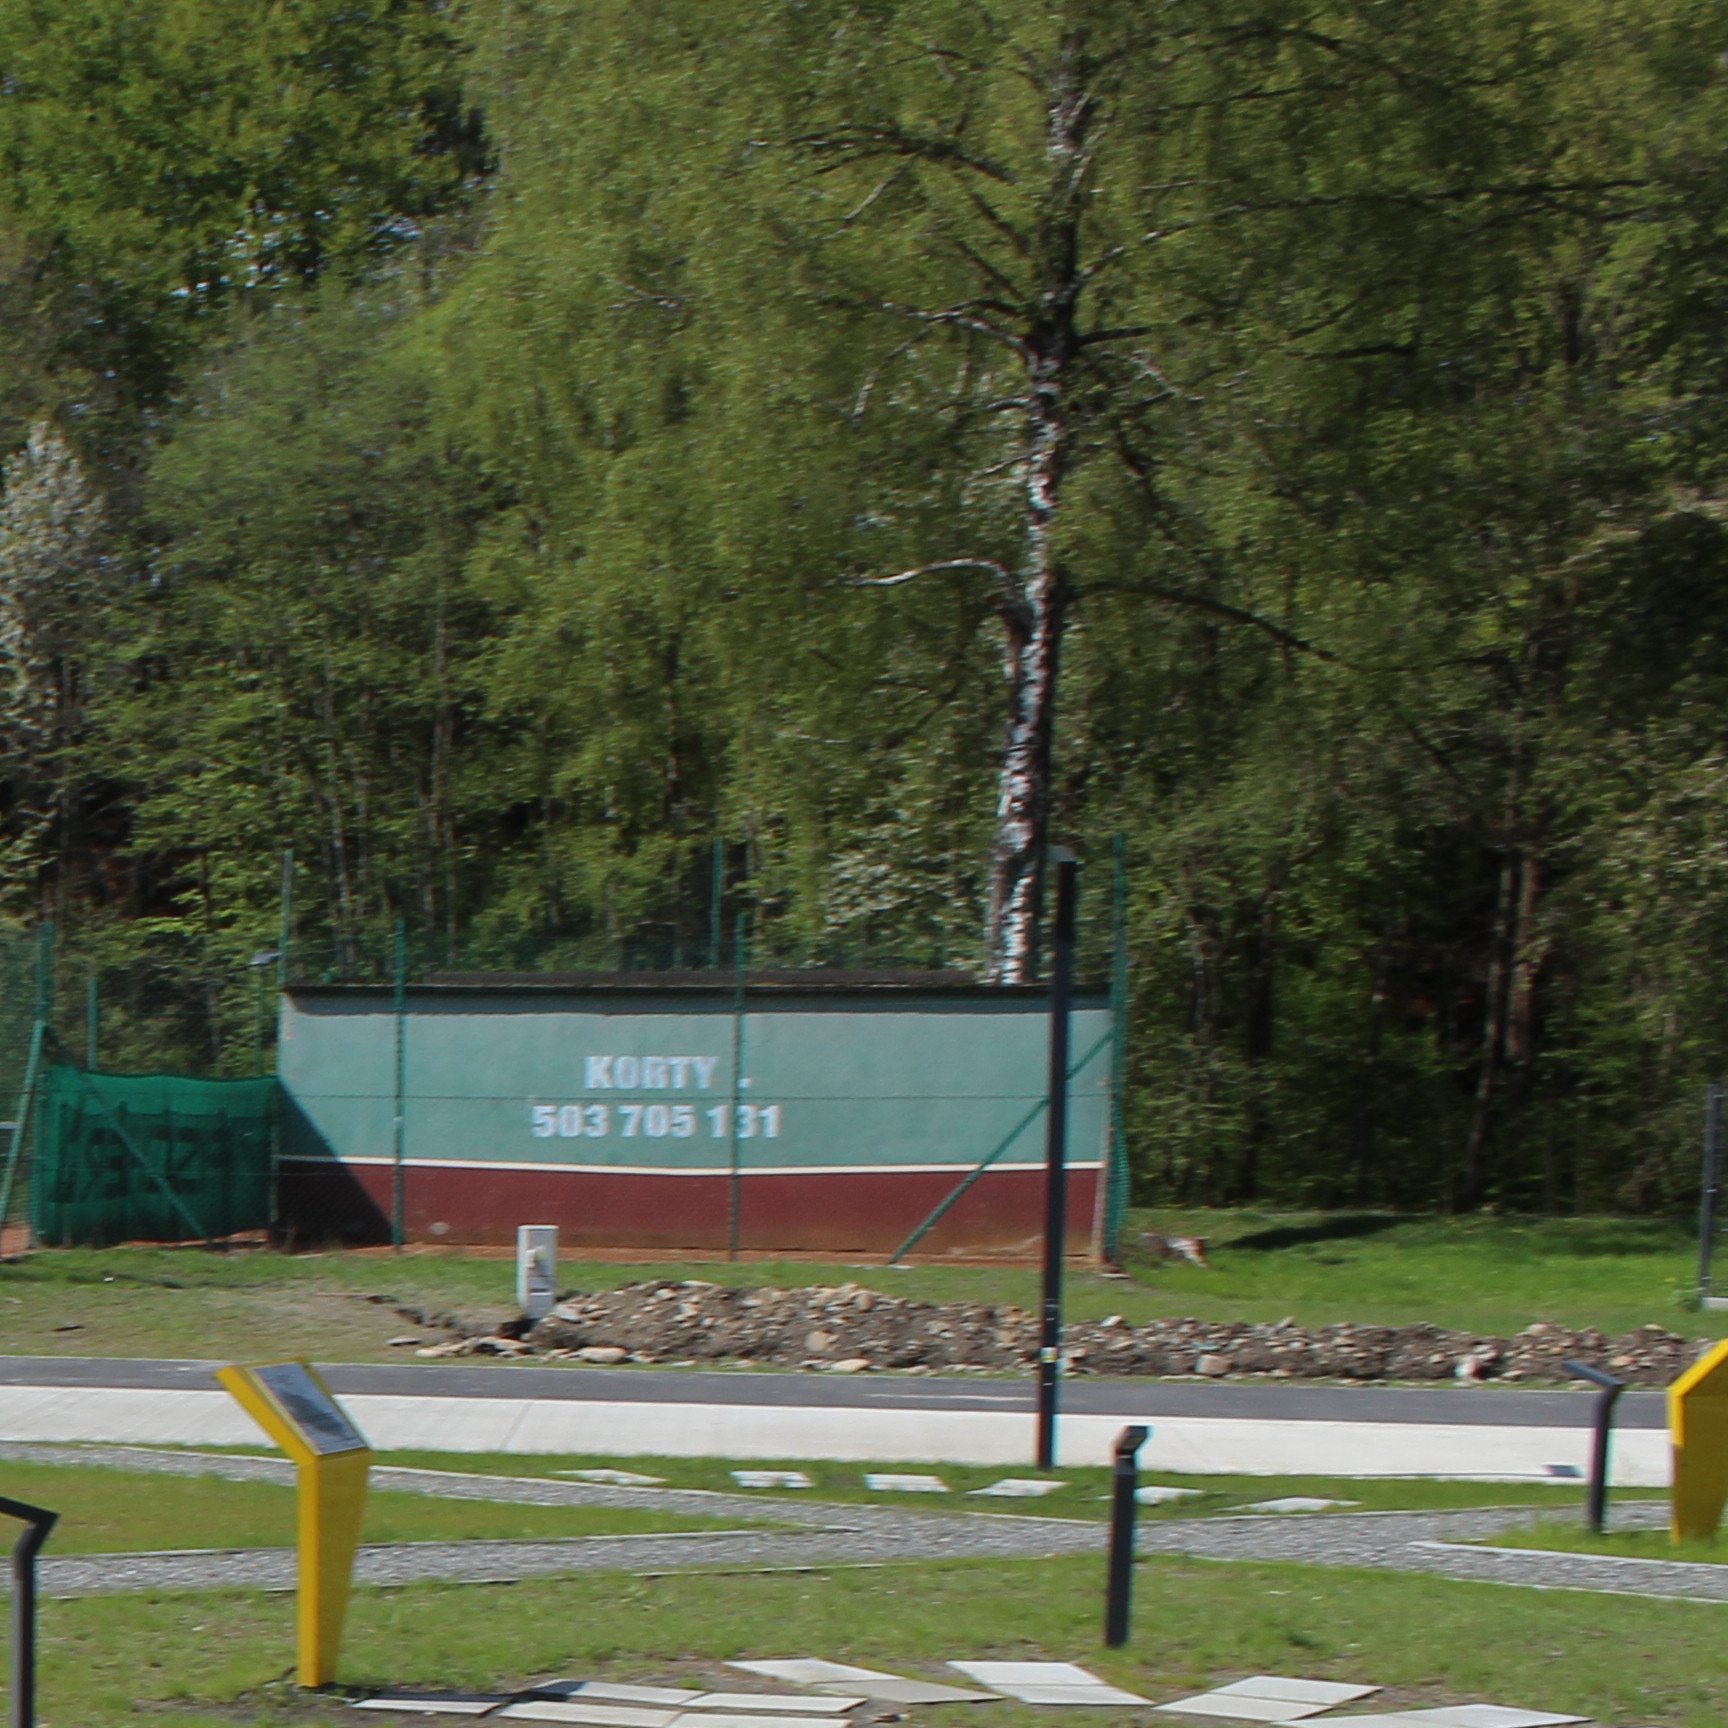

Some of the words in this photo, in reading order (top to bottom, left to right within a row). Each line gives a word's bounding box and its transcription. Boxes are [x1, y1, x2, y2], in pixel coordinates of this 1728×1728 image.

[584, 1055, 719, 1090] KORTY
[531, 1104, 610, 1138] 503
[618, 1104, 696, 1138] 705
